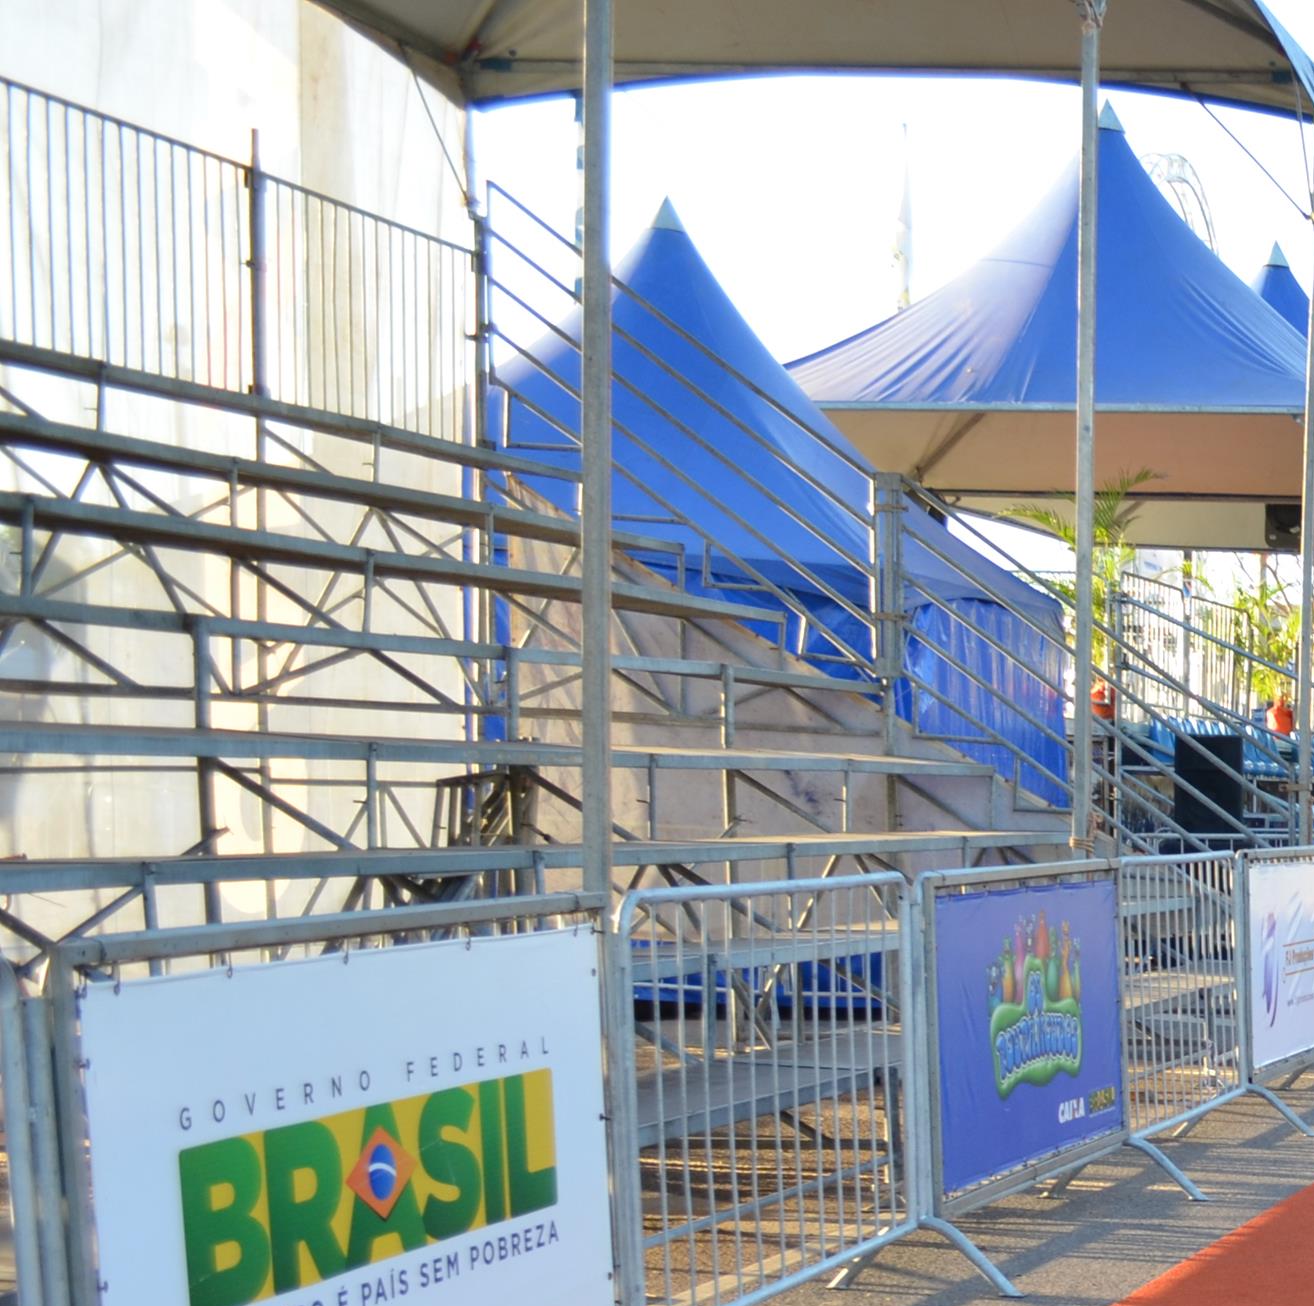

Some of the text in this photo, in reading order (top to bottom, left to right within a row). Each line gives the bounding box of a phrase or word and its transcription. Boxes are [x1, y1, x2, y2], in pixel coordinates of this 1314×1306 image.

[179, 1035, 550, 1131] GOVERNO FEDERAL
[1058, 1096, 1086, 1124] CAIXA
[419, 1257, 461, 1292] SEM
[469, 1220, 560, 1269] POBREZA
